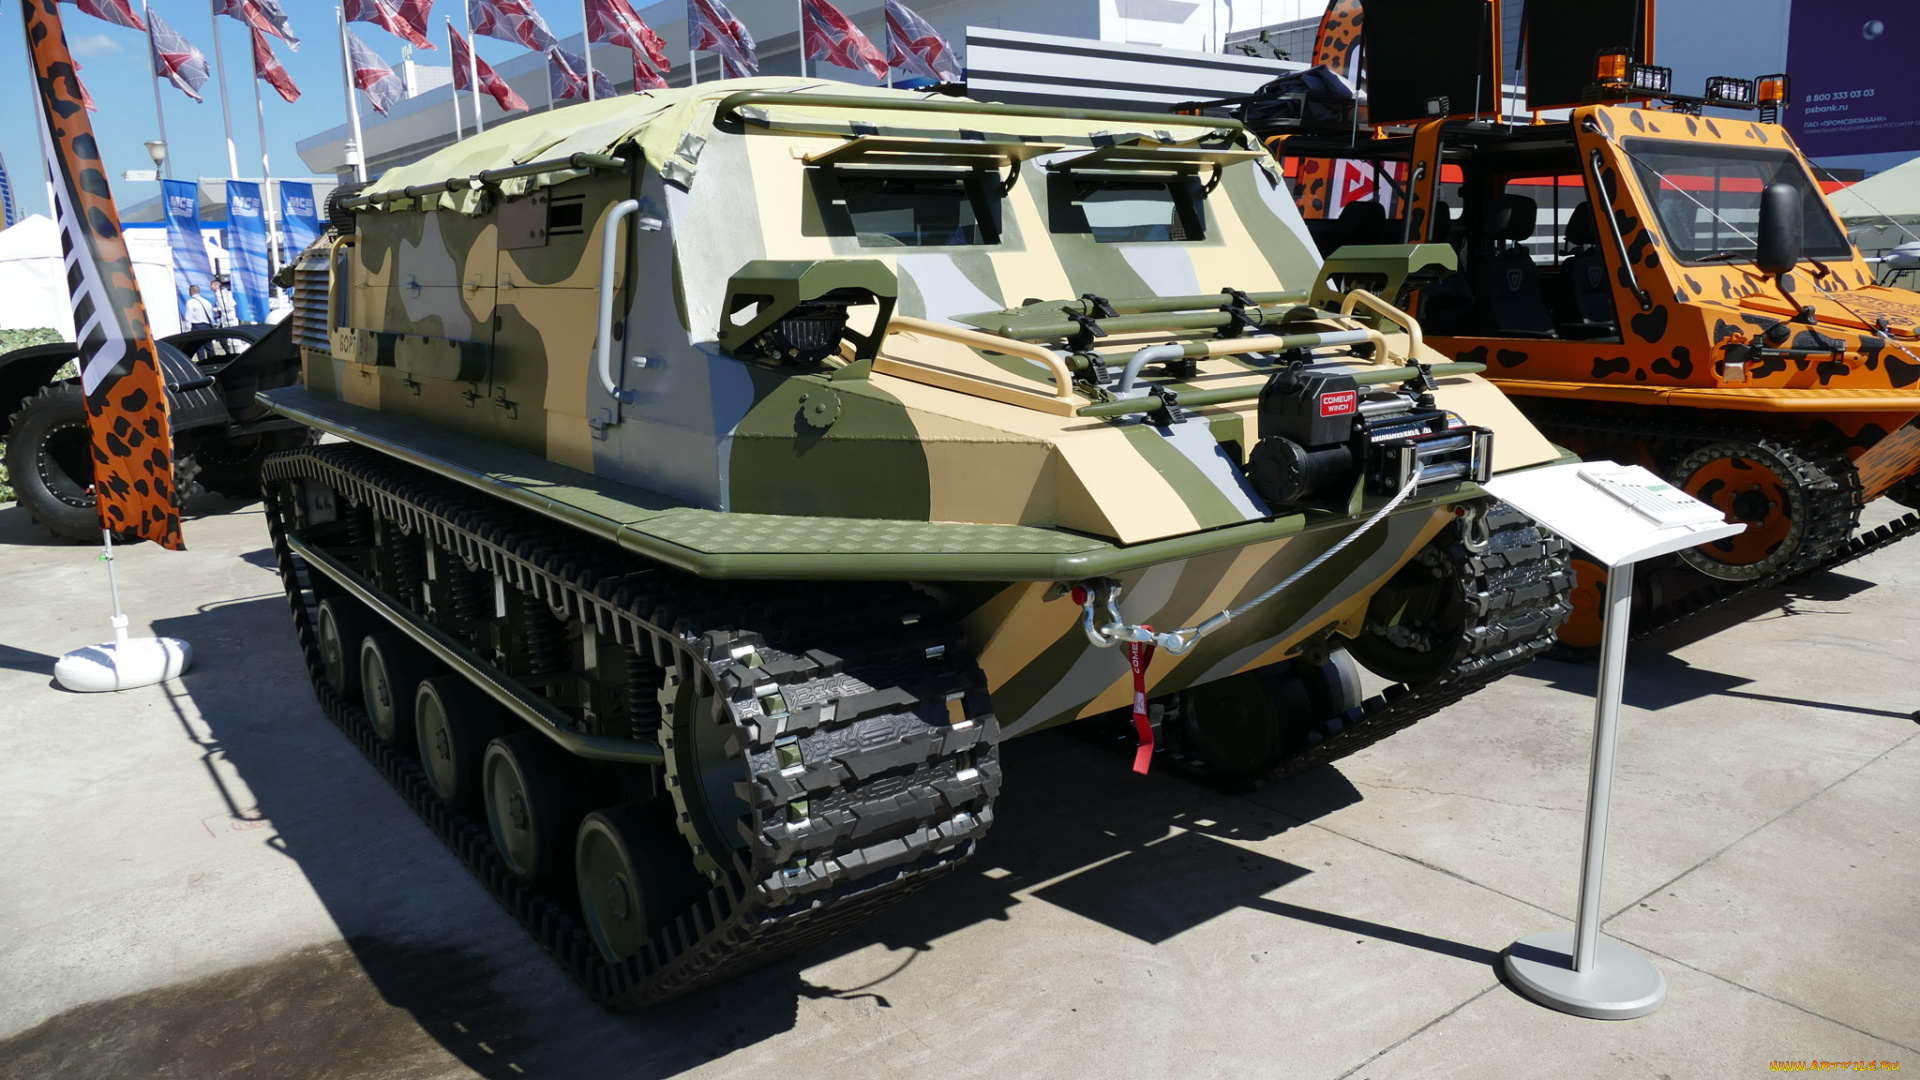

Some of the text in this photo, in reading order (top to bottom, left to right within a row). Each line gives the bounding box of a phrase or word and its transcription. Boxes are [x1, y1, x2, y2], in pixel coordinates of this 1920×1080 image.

[1813, 93, 1831, 102] 800
[1833, 91, 1848, 100] 333
[1850, 90, 1861, 98] 03
[1863, 89, 1875, 97] 03
[1805, 104, 1849, 115] psbank.ru
[1323, 394, 1353, 405] COMEUP
[1328, 404, 1348, 412] WINCH
[1132, 643, 1140, 674] COME
